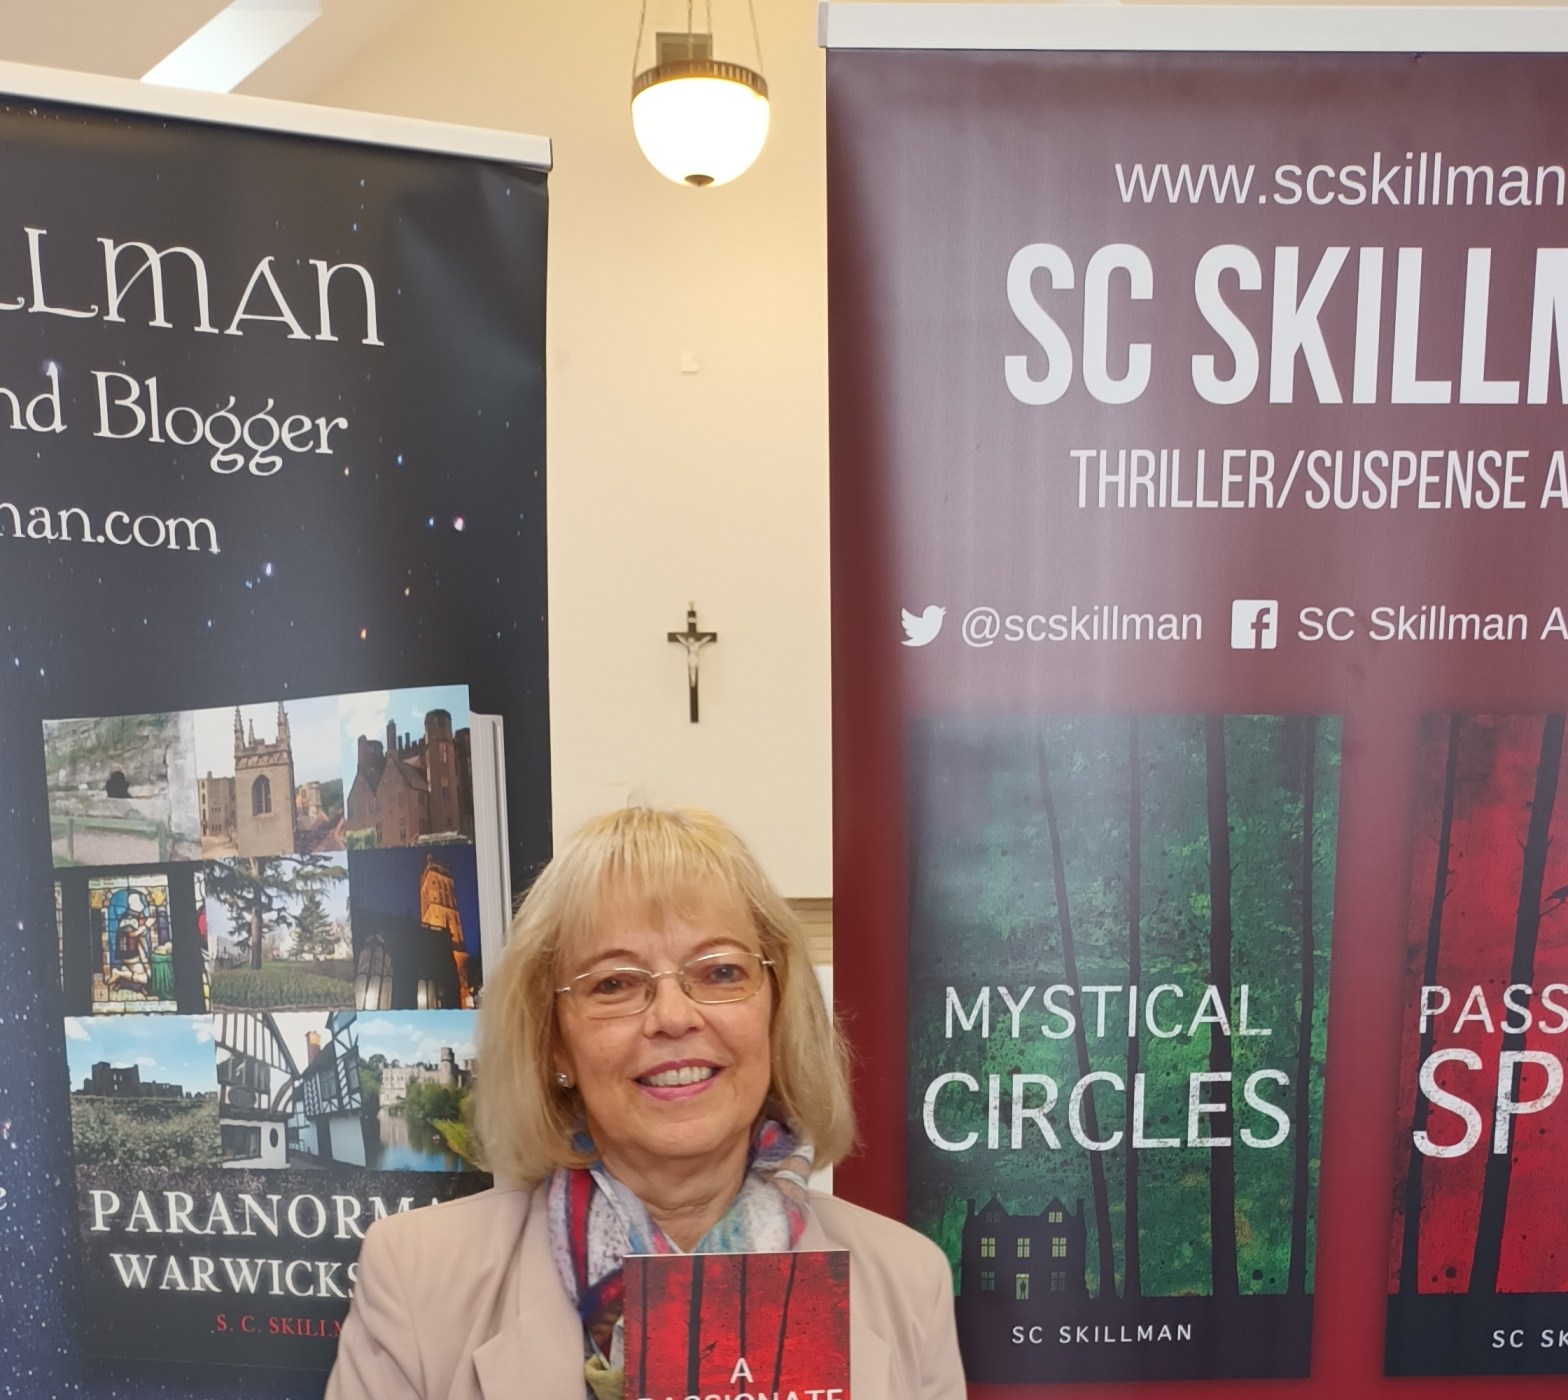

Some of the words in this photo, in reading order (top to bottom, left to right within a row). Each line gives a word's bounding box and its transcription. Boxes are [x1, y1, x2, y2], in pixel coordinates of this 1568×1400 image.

[1115, 152, 1566, 206] www.scskillman
[0, 227, 385, 346] LMAN
[1005, 243, 1154, 405] SC
[91, 370, 349, 476] Blogger
[1070, 449, 1530, 510] THRILLER/SUSPENSE
[1540, 450, 1568, 509] A
[961, 606, 1203, 648] @scskillman
[1298, 607, 1356, 641] SC
[1369, 606, 1528, 641] Skillman
[1540, 607, 1568, 641] A
[944, 982, 1273, 1040] MYSTICAL
[1417, 983, 1568, 1035] PASS
[922, 1068, 1292, 1152] CIRCLES
[1412, 1047, 1564, 1159] SP
[89, 1189, 439, 1240] PARANOR
[216, 1313, 234, 1332] S.
[241, 1314, 262, 1334] C.
[1012, 1325, 1044, 1345] SC
[1058, 1323, 1193, 1345] SKILLMAN
[1492, 1329, 1525, 1348] SC
[729, 1357, 754, 1384] A
